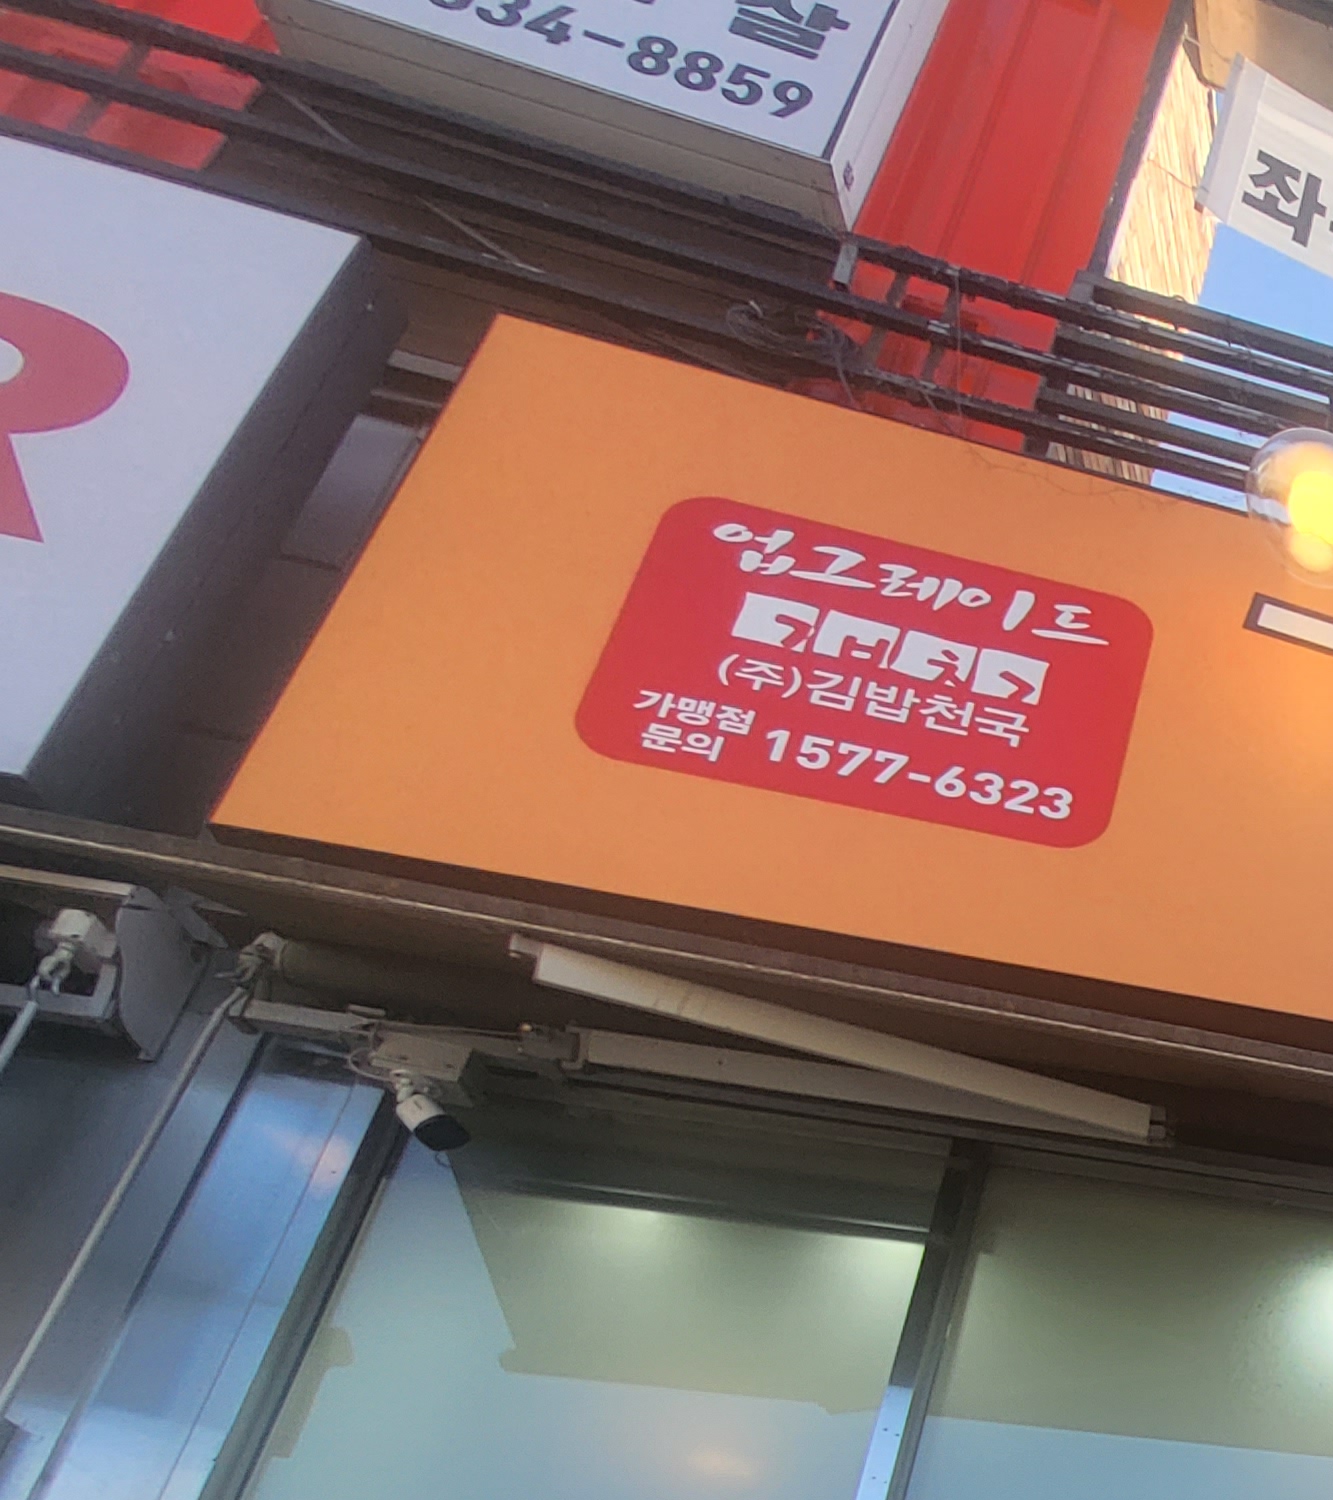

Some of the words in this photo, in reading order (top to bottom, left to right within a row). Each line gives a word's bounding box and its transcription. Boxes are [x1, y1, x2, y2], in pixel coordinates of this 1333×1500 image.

[430, 0, 813, 118] 34-8859
[633, 688, 757, 737] 가맹점
[640, 722, 726, 763] 문의
[719, 653, 1030, 748] (주)김밥천국
[764, 729, 1073, 821] 1577-6323
